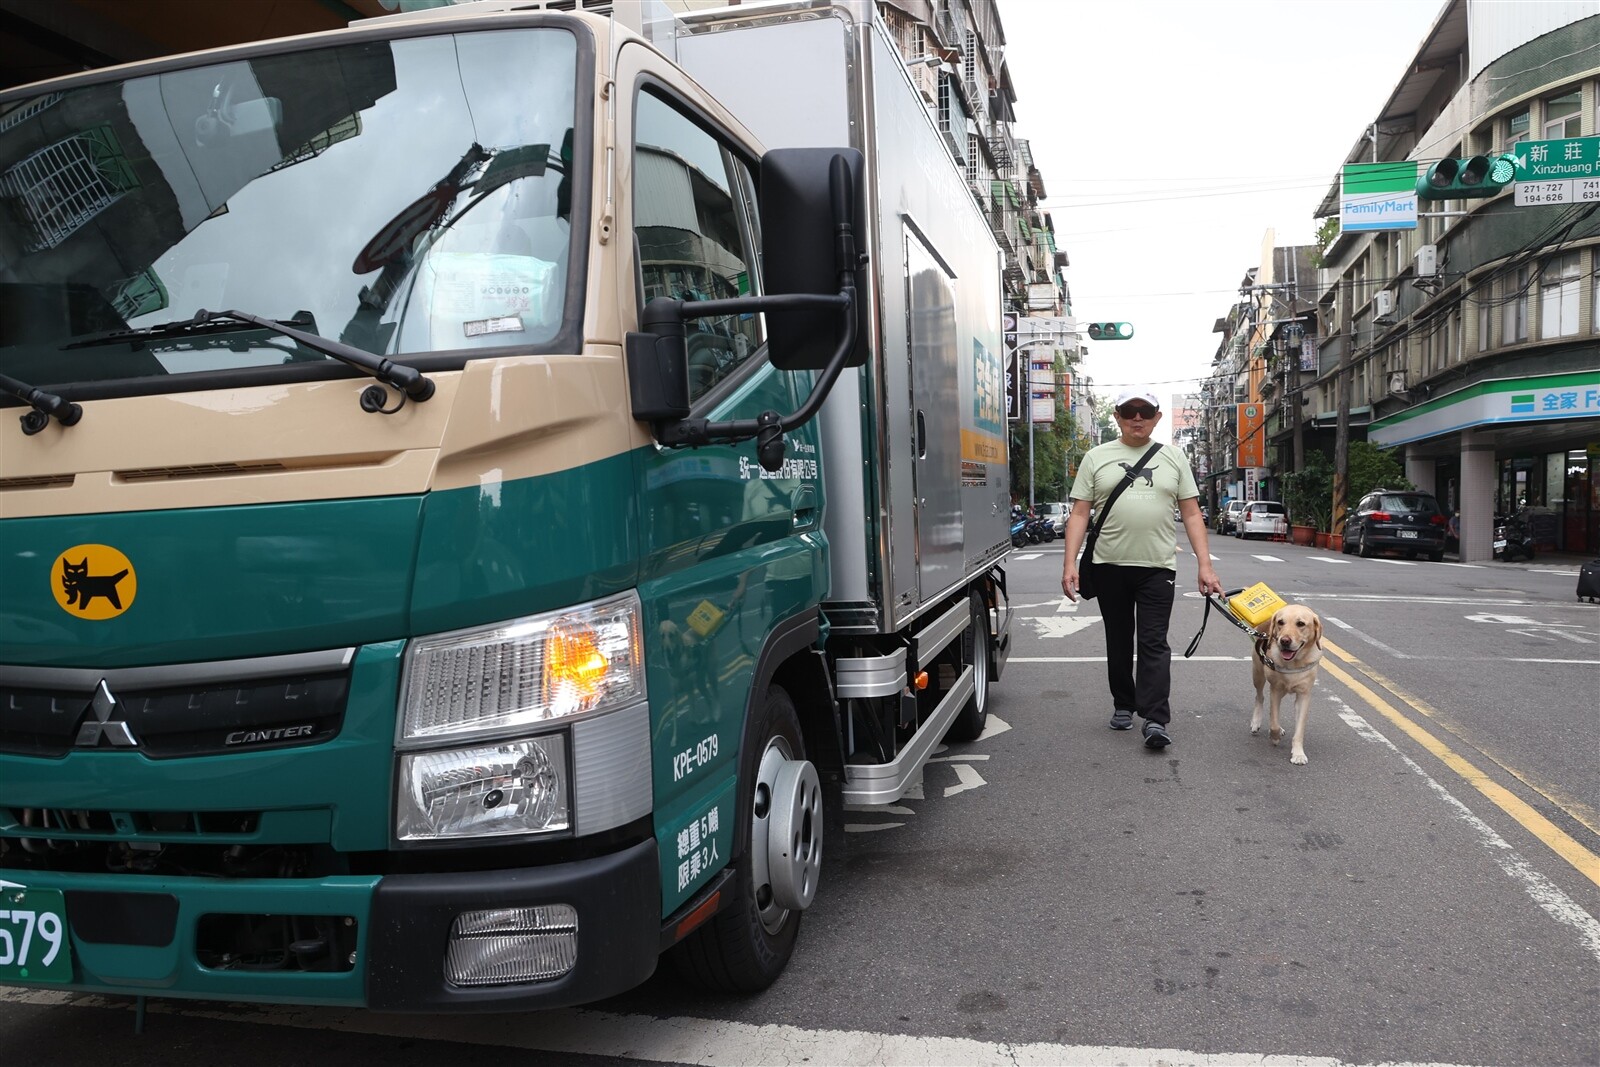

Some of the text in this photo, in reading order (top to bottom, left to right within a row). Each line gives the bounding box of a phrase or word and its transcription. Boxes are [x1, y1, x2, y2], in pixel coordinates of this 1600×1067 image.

[1530, 141, 1600, 162] 新莊
[1532, 163, 1592, 175] Xinzhuang
[1524, 184, 1563, 193] 271-727
[1524, 193, 1563, 203] 194-626
[1345, 200, 1414, 215] FamilyMart
[1542, 392, 1578, 411] 全家
[225, 725, 312, 745] CANTER
[673, 734, 718, 782] KPE-0579
[677, 838, 719, 893] 限乘3人
[0, 910, 63, 967] 579
